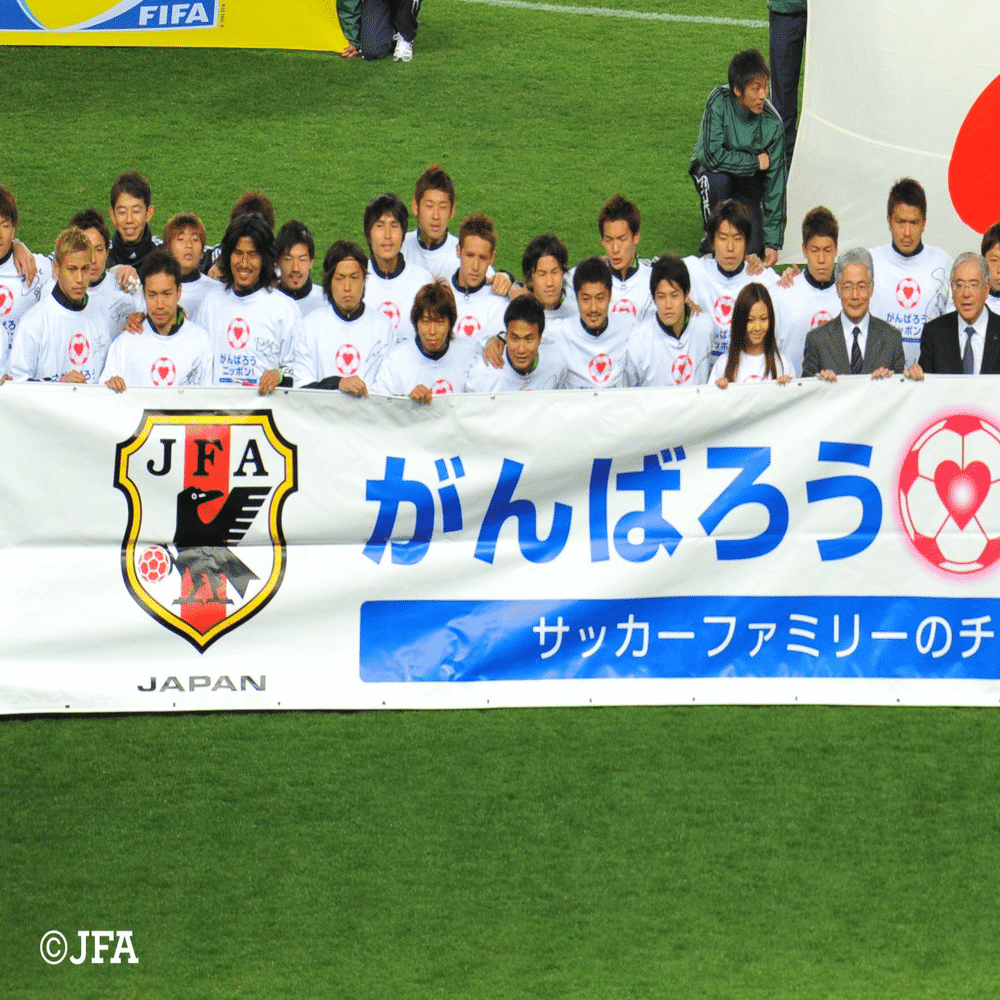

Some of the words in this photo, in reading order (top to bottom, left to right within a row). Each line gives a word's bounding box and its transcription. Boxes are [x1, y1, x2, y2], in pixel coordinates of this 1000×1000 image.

[138, 2, 209, 26] FIFA
[146, 438, 269, 477] JFA
[362, 440, 884, 566] がんばろう
[137, 675, 266, 692] JAPAN
